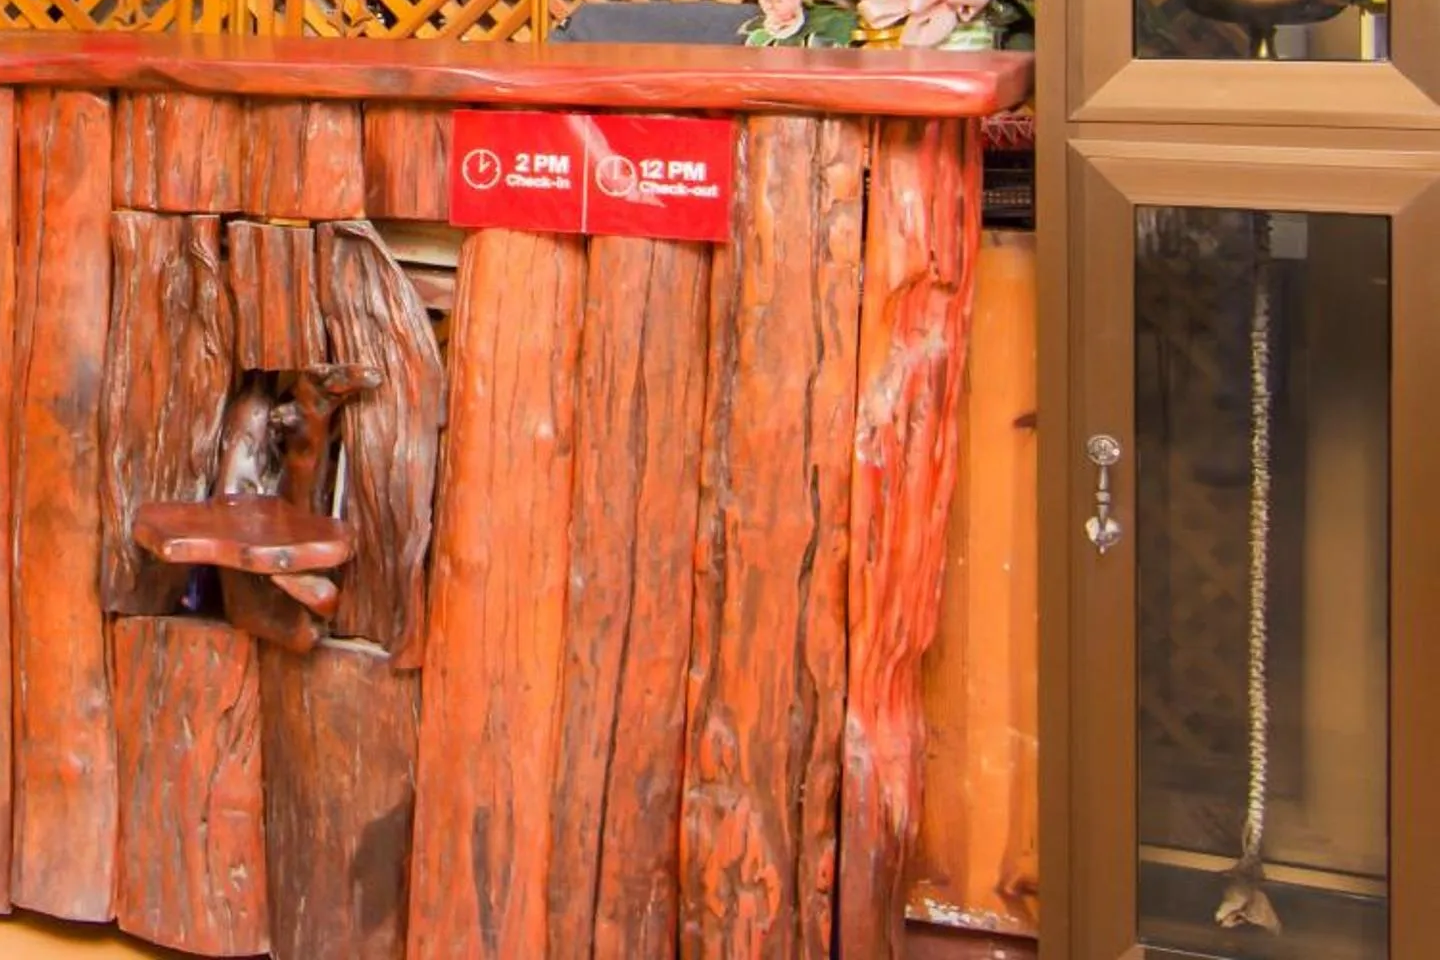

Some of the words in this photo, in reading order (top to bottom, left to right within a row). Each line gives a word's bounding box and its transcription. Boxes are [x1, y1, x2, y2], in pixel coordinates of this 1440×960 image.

[515, 154, 530, 172] 2
[534, 155, 570, 174] PM
[640, 160, 662, 179] 12
[668, 161, 708, 181] PM
[505, 174, 572, 189] Check-in
[639, 182, 718, 198] Check-out
